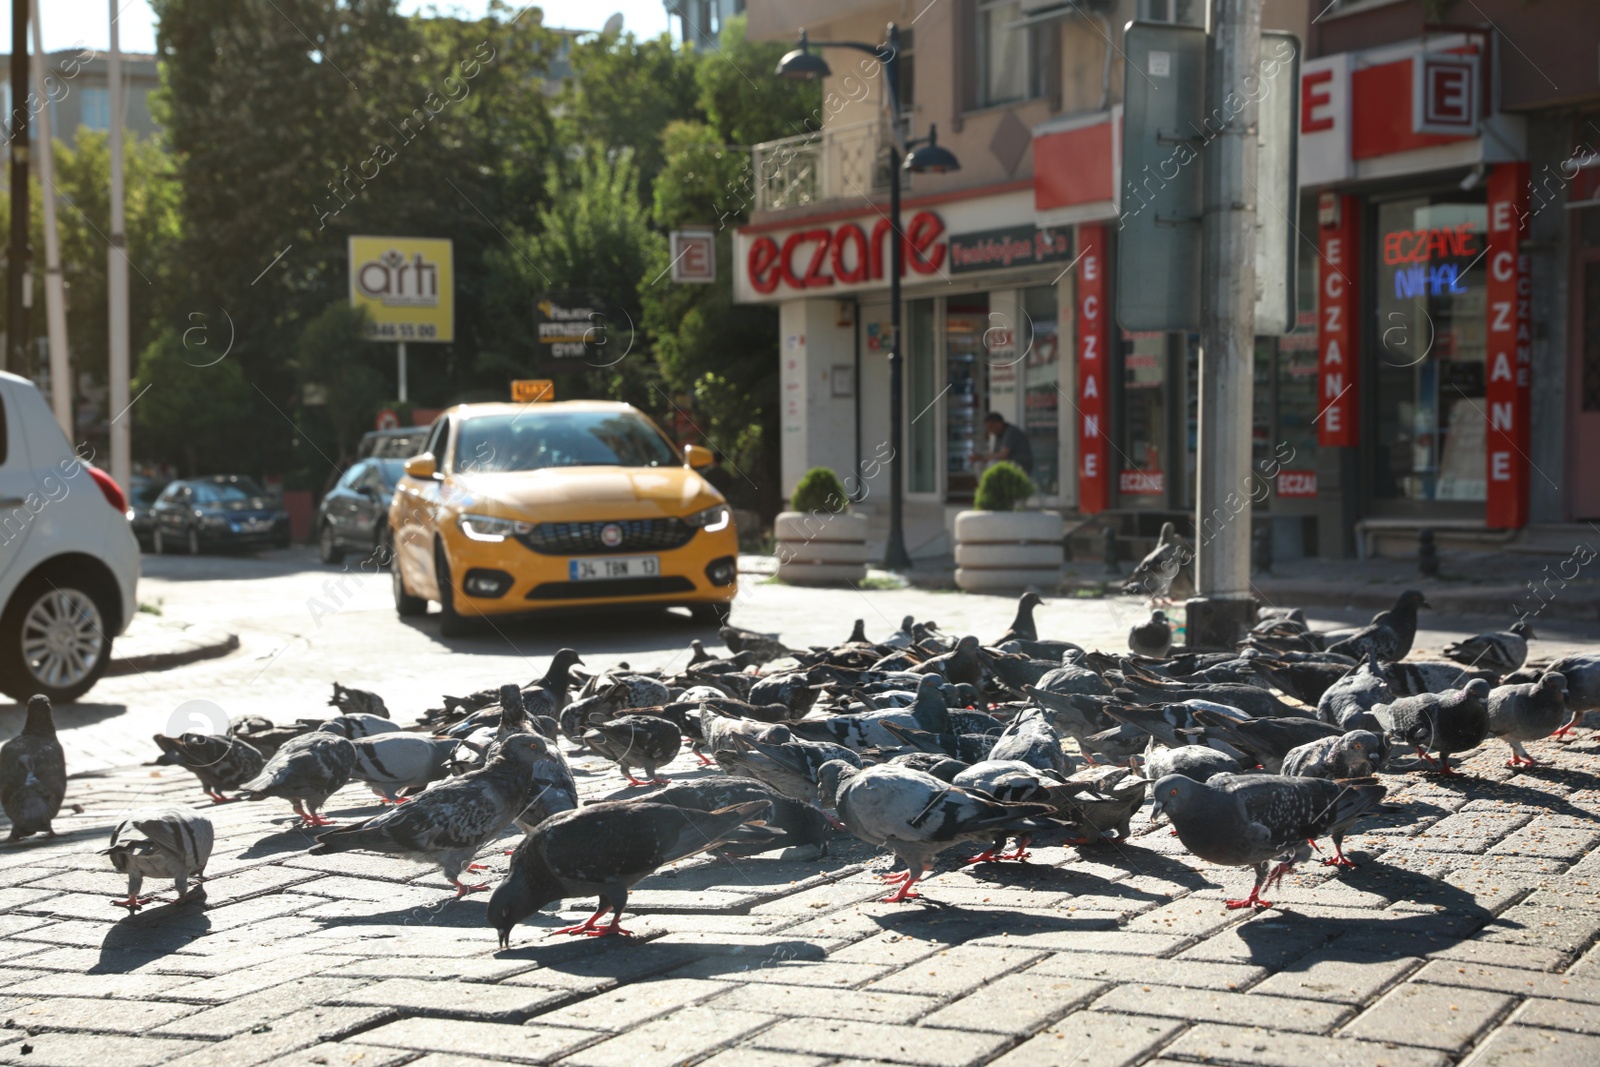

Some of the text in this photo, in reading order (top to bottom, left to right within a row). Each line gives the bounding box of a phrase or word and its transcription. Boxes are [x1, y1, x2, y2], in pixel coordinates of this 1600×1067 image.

[1433, 70, 1464, 118] E
[684, 243, 706, 271] E
[747, 211, 947, 294] eczane
[1383, 221, 1477, 266] ECZANE
[1325, 239, 1343, 432] ECZANE
[1490, 201, 1512, 481] ECZANE
[1516, 255, 1530, 388] ECZANE
[1083, 256, 1099, 477] ECZANE
[1120, 472, 1165, 491] ECZANE
